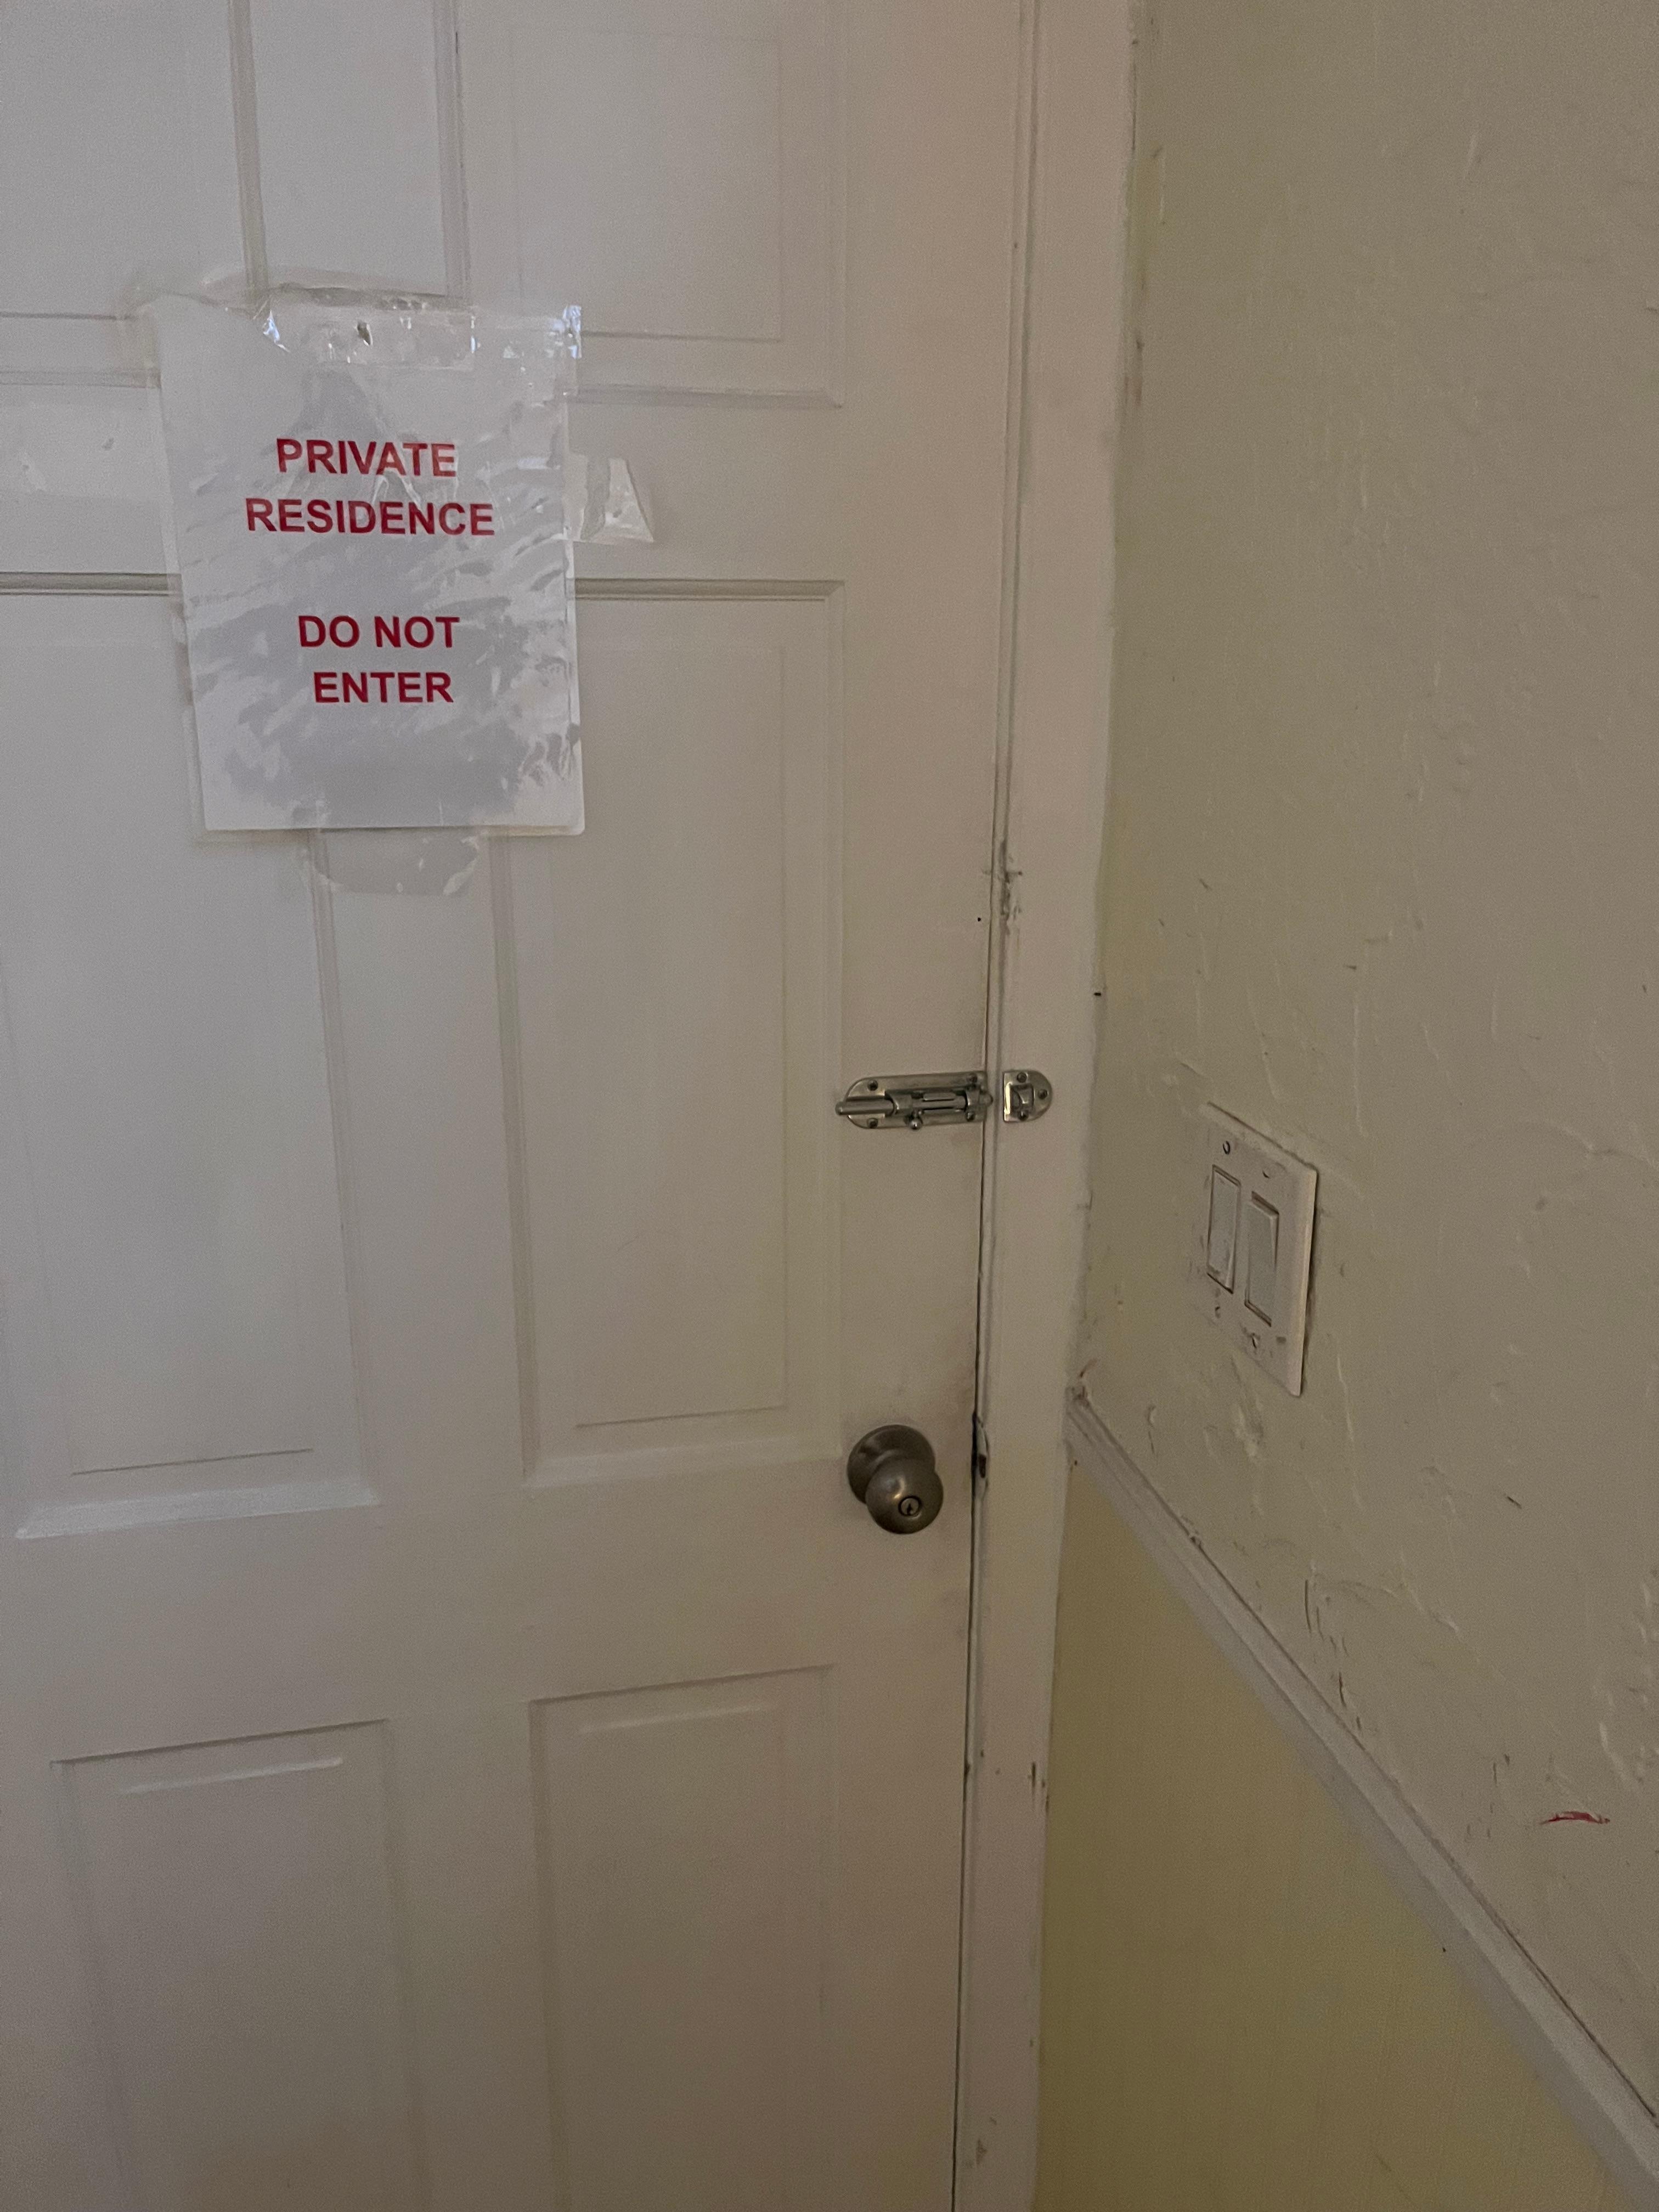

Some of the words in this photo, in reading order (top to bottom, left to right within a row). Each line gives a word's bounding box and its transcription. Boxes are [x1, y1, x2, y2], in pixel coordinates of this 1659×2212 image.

[276, 438, 456, 477] PRIVATE
[245, 498, 494, 535] RESIDENCE
[298, 616, 360, 648] DO
[374, 616, 459, 648] NOT
[313, 672, 453, 703] ENTER
